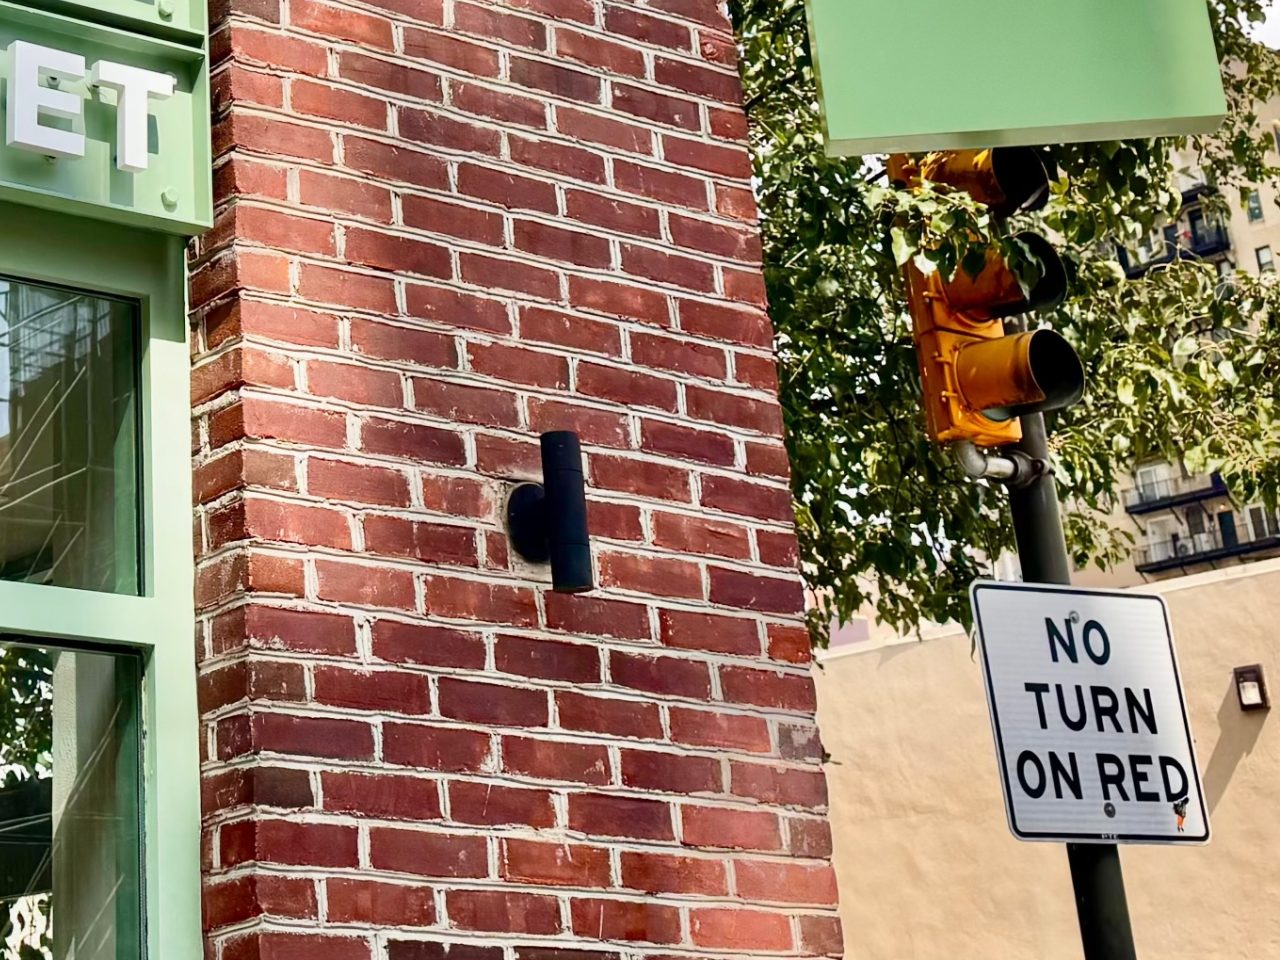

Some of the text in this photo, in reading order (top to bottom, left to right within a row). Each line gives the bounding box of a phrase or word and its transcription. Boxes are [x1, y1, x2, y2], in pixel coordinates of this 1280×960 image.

[1045, 617, 1111, 665] NO
[1024, 682, 1158, 734] TURN
[1017, 750, 1083, 799] ON
[1096, 753, 1189, 802] RED
